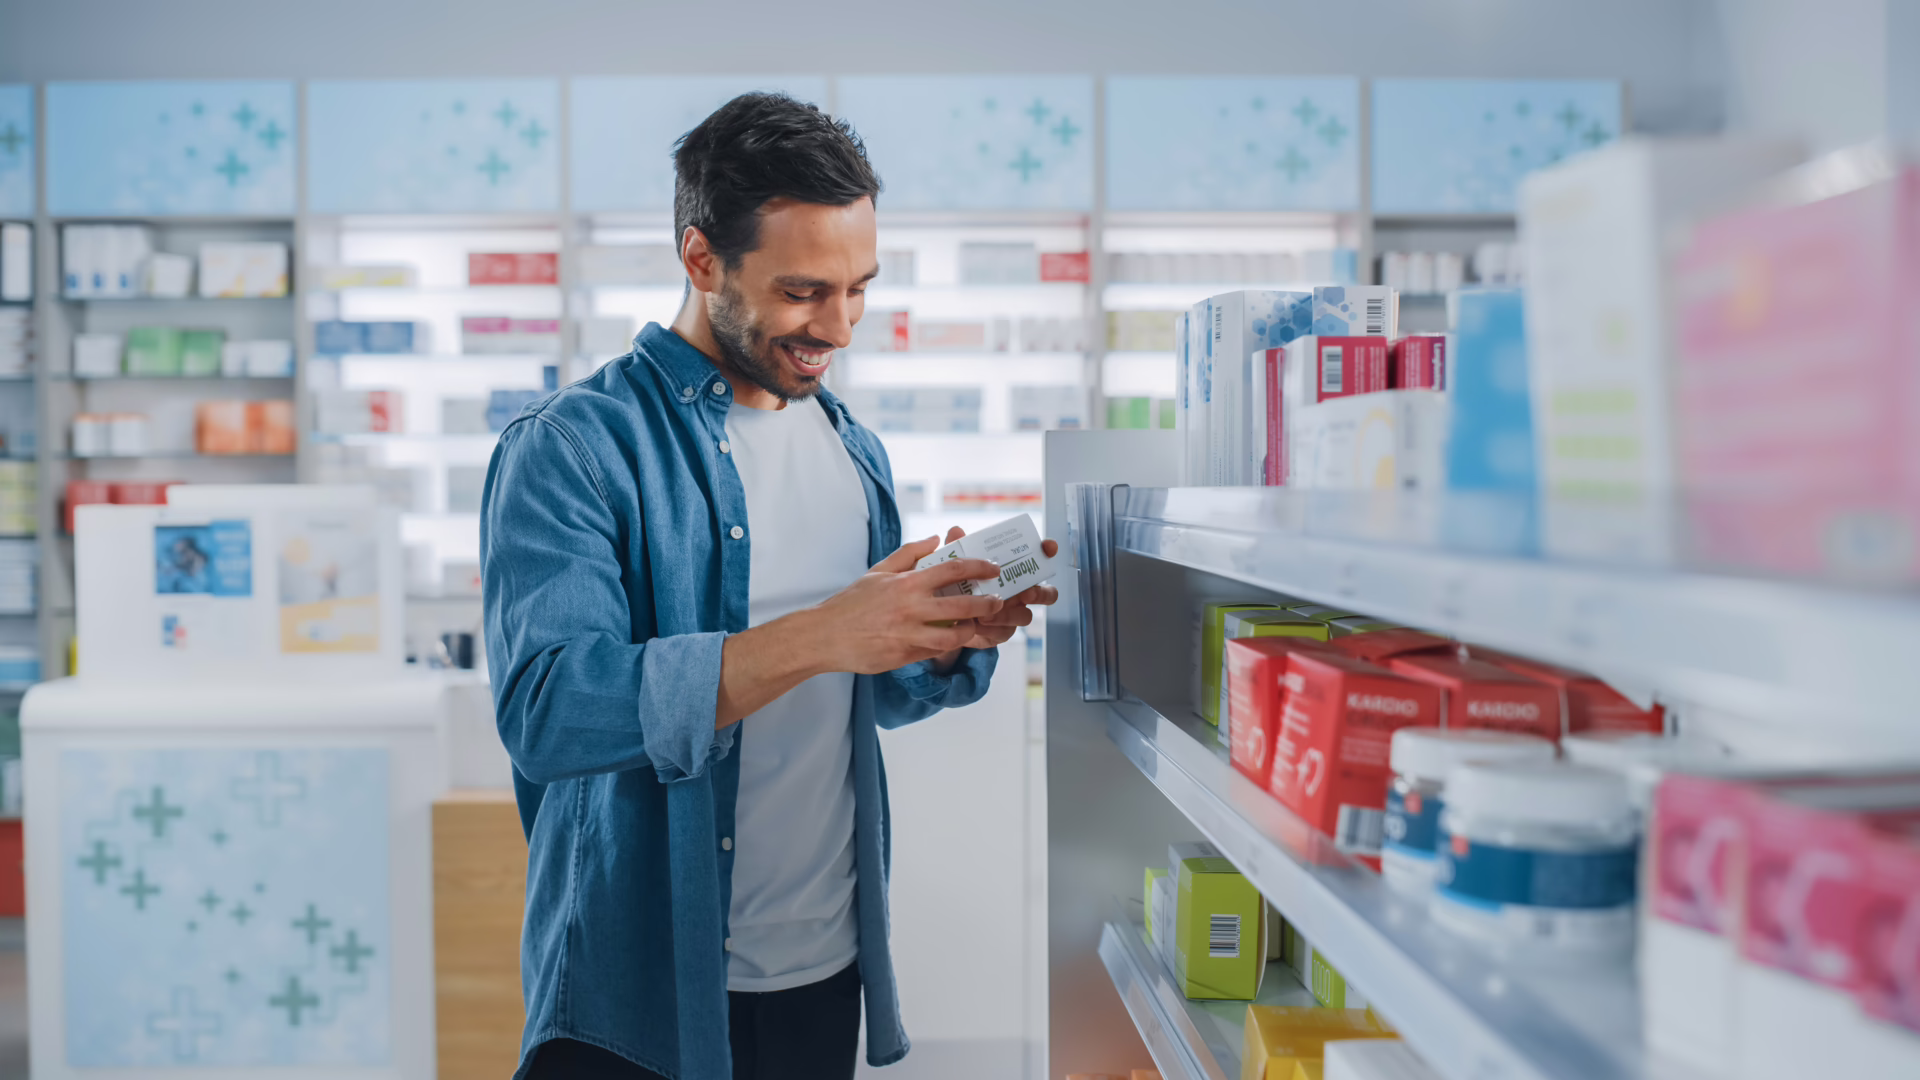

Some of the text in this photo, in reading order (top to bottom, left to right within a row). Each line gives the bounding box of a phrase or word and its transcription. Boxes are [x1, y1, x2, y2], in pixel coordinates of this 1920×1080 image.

[1002, 557, 1040, 584] Vitamin
[1347, 692, 1419, 717] KARDIO
[1467, 700, 1540, 721] KARDIO
